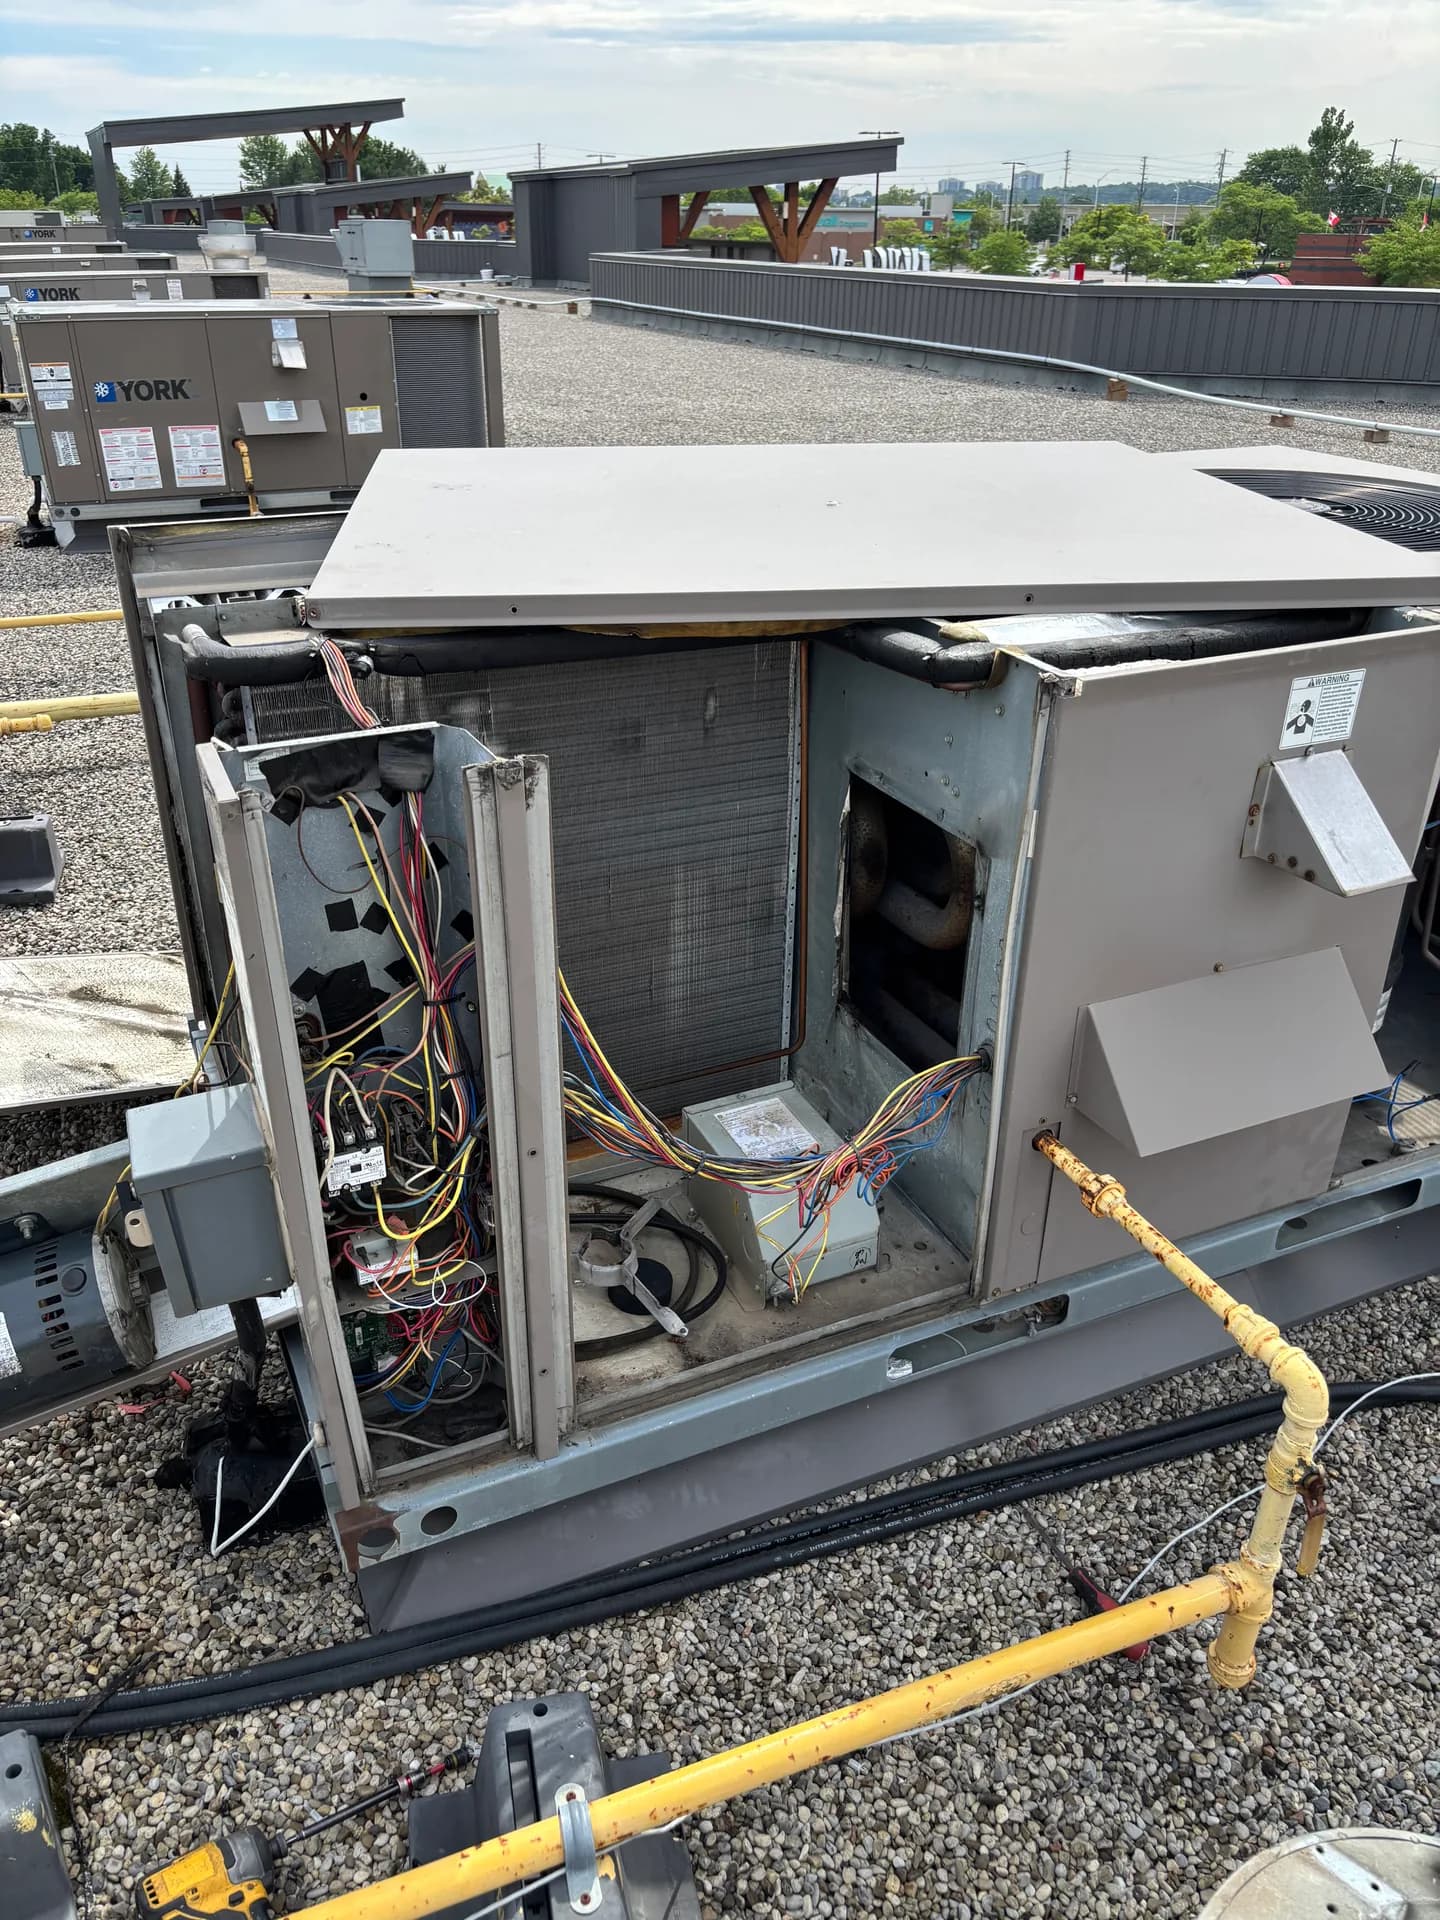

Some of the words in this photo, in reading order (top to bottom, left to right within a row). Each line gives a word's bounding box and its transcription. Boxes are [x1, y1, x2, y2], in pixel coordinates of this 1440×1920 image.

[32, 229, 56, 238] YORK
[39, 287, 80, 301] YORK
[116, 379, 190, 402] YORK
[1315, 673, 1350, 687] WARNING
